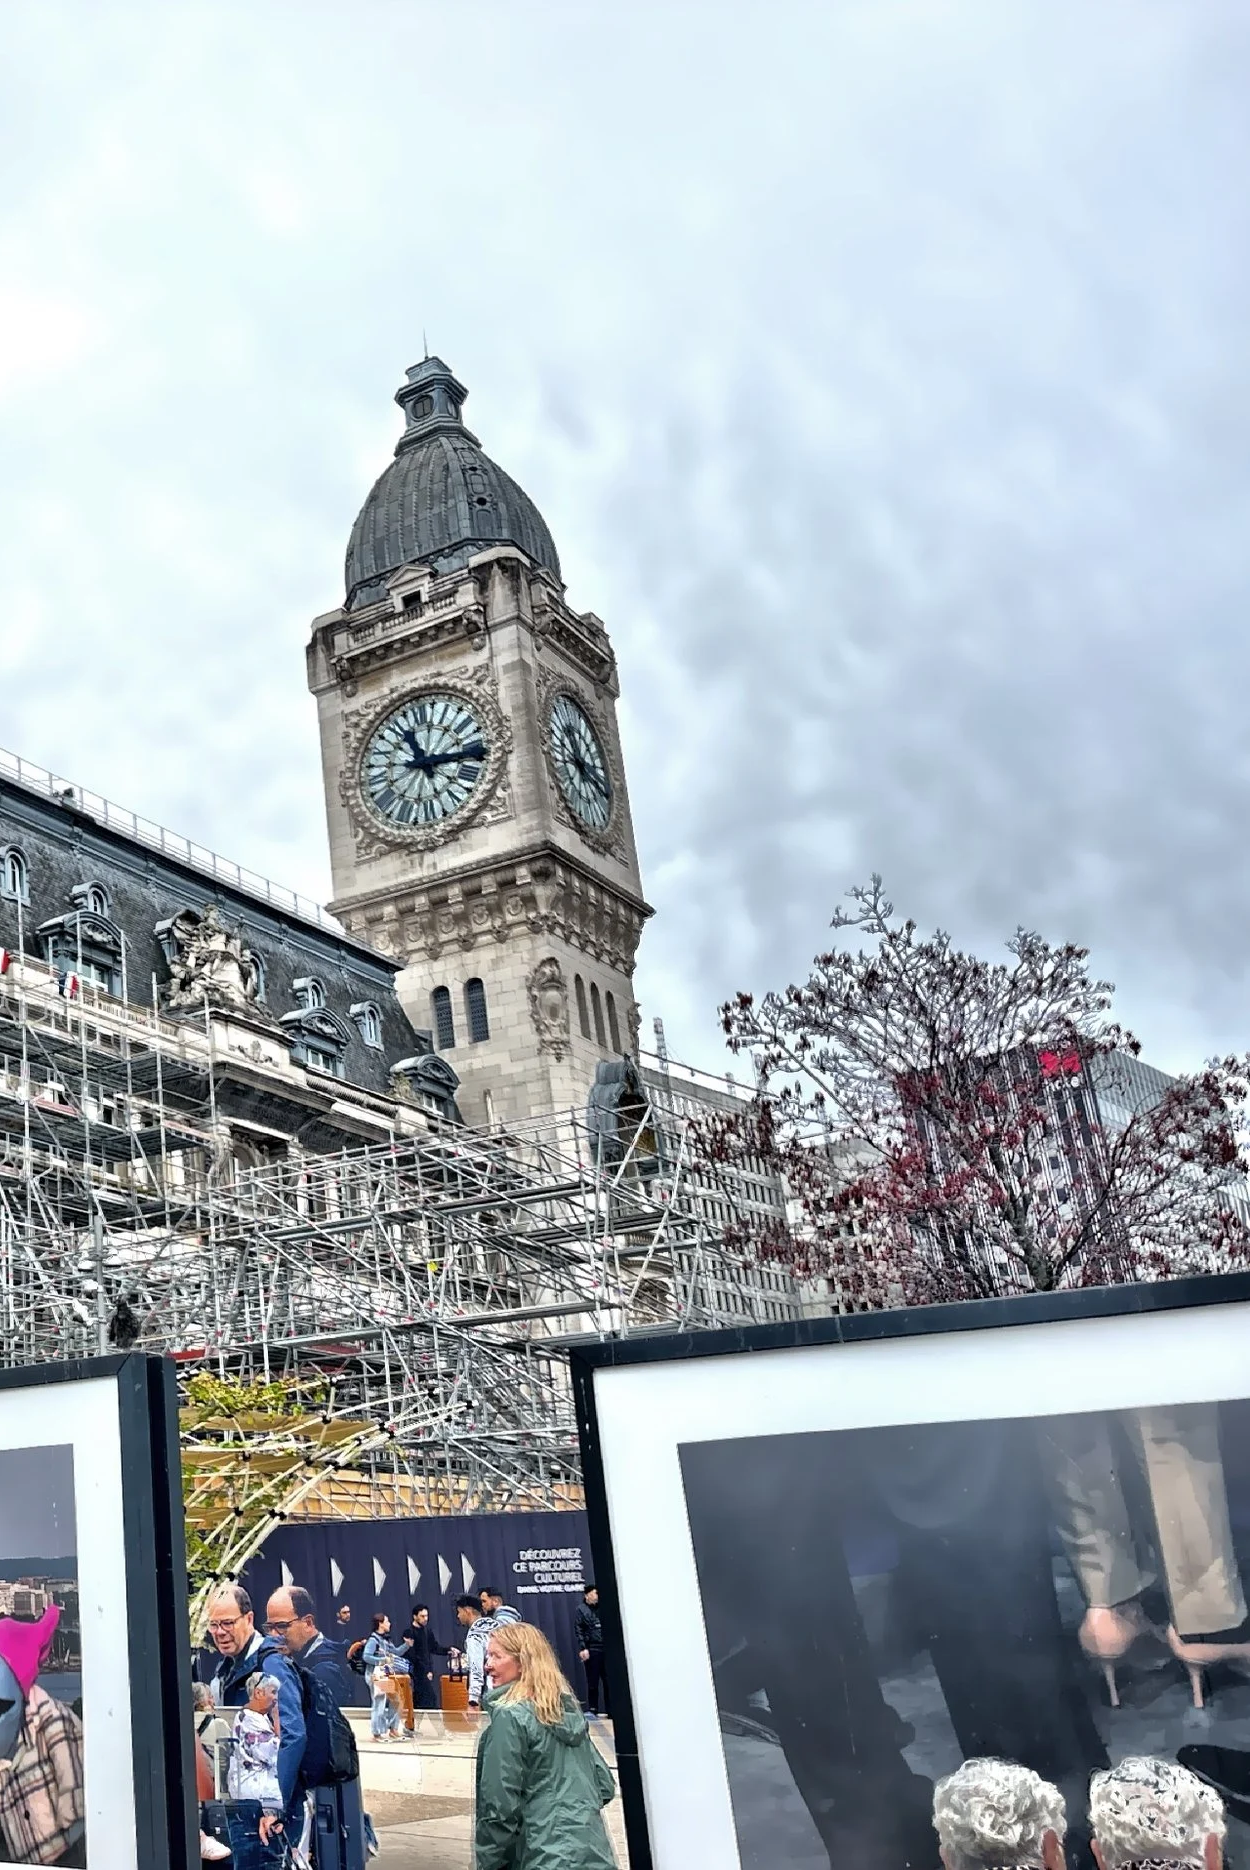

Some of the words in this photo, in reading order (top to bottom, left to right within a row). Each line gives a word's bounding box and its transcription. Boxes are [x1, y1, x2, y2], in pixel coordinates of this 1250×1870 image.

[519, 1547, 582, 1560] DÉCOUVREZ
[512, 1562, 528, 1573] CE
[528, 1560, 583, 1572] PARCOURS
[534, 1572, 585, 1583] CULTUREL
